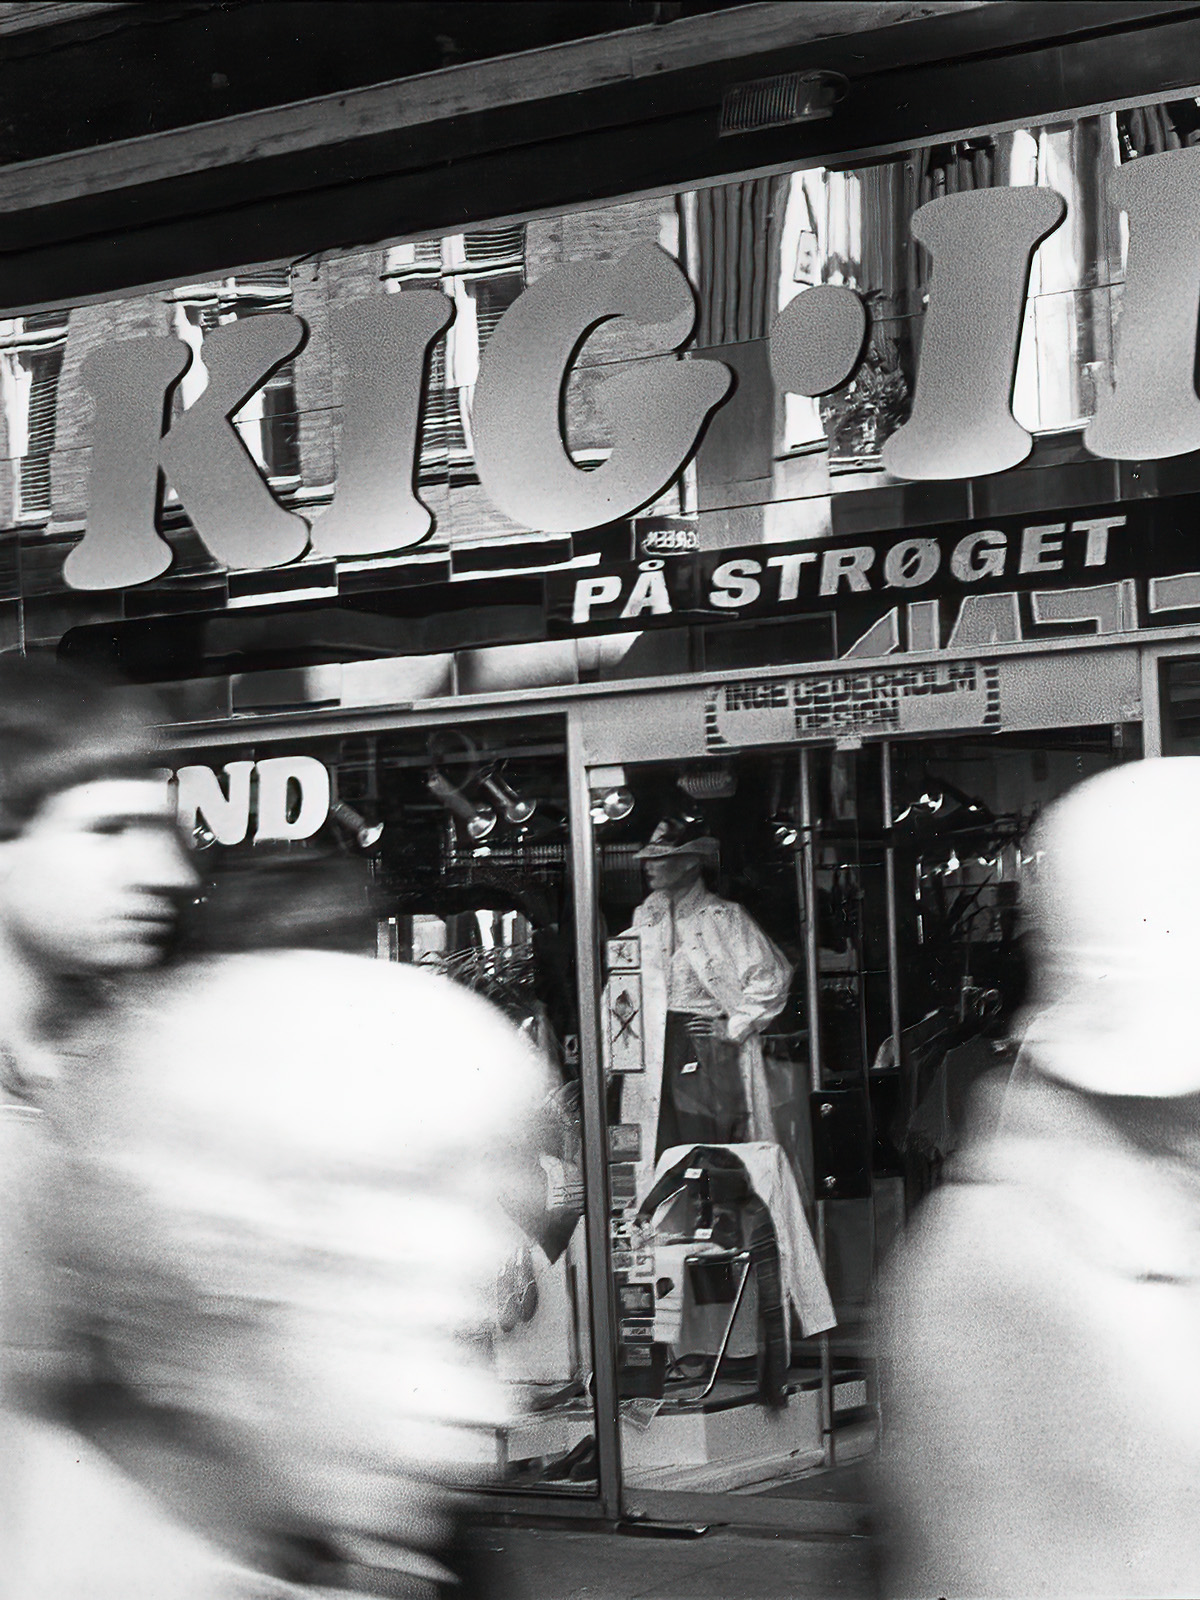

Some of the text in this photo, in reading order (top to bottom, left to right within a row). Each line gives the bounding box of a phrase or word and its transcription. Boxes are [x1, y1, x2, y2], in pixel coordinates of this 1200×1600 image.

[572, 514, 1127, 625] PÅ STRØGET
[150, 755, 330, 846] ND
